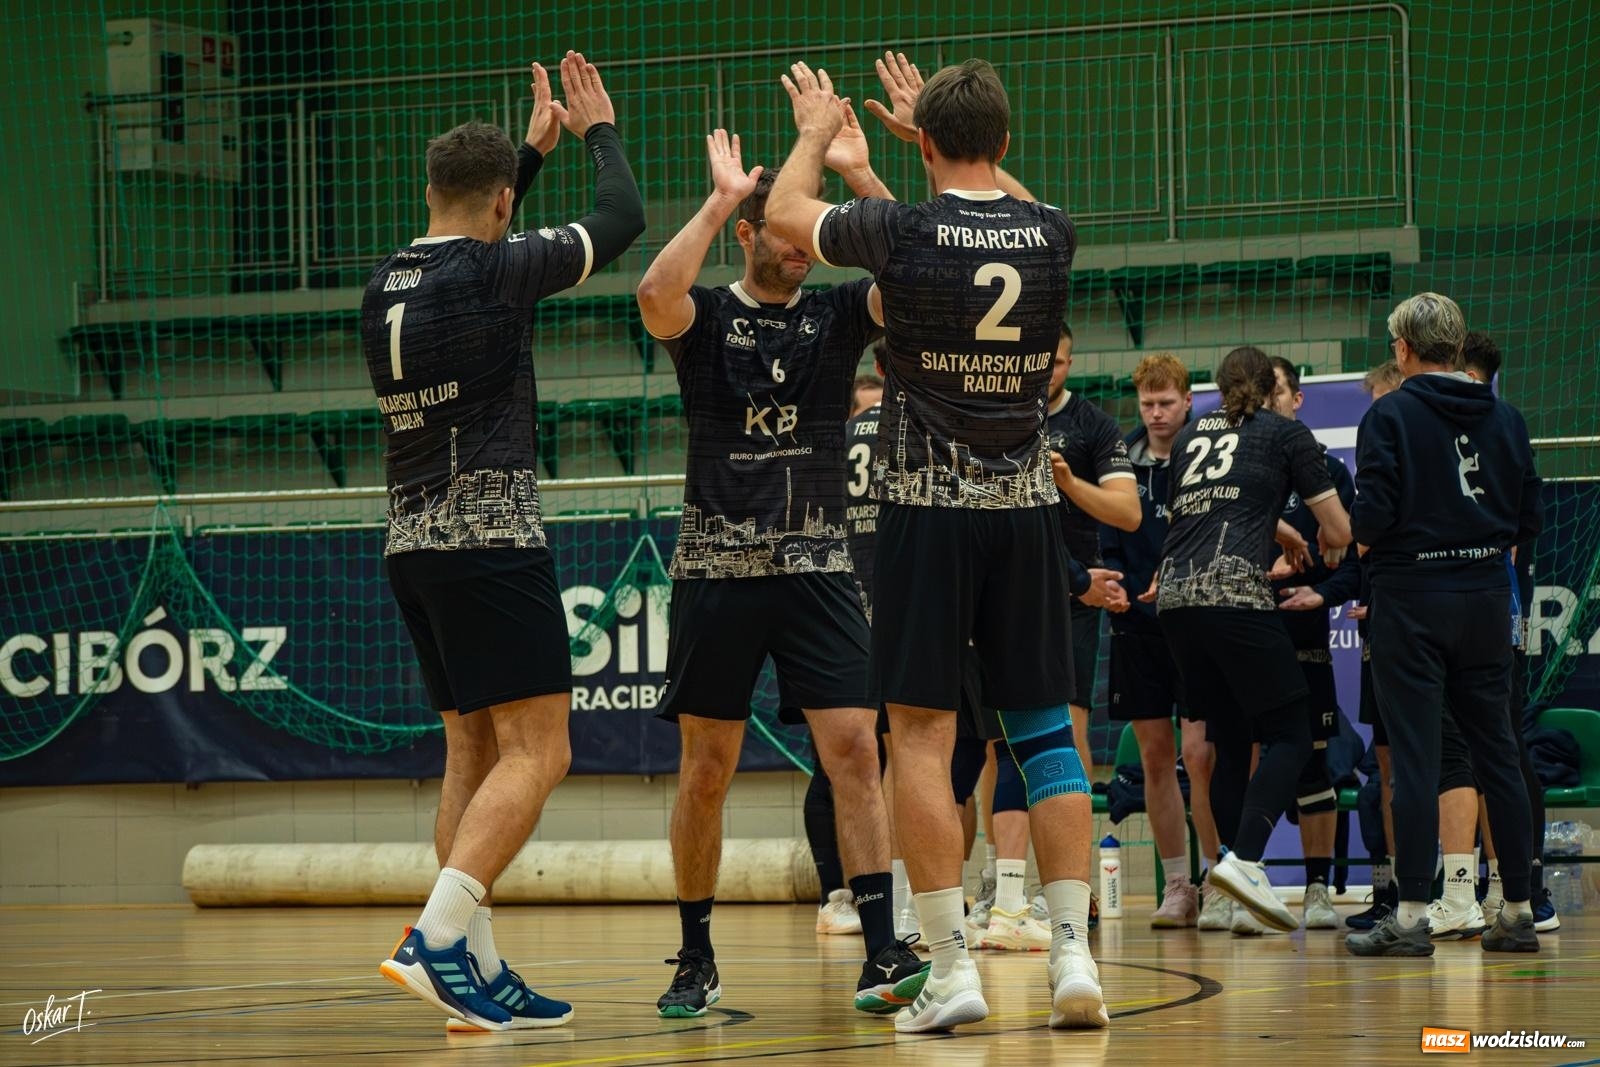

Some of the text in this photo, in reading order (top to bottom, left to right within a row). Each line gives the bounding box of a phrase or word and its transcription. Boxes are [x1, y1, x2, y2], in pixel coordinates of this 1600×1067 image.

[937, 225, 1049, 250] RYBARCZYK
[383, 268, 422, 292] DZIDO
[973, 262, 1022, 342] 2
[385, 302, 406, 381] 1
[772, 358, 786, 383] 6
[921, 351, 1051, 374] SIATKARSKI KLUB
[419, 381, 459, 408] KLUB
[963, 374, 1022, 393] RADLIN
[390, 411, 425, 432] RADLIN
[853, 421, 879, 435] TERL
[847, 443, 871, 498] 3
[1180, 433, 1240, 488] 23
[1212, 485, 1240, 499] KLUB
[855, 519, 876, 533] RADL
[560, 585, 671, 676] Sil
[0, 605, 288, 698] CIBÓRZ
